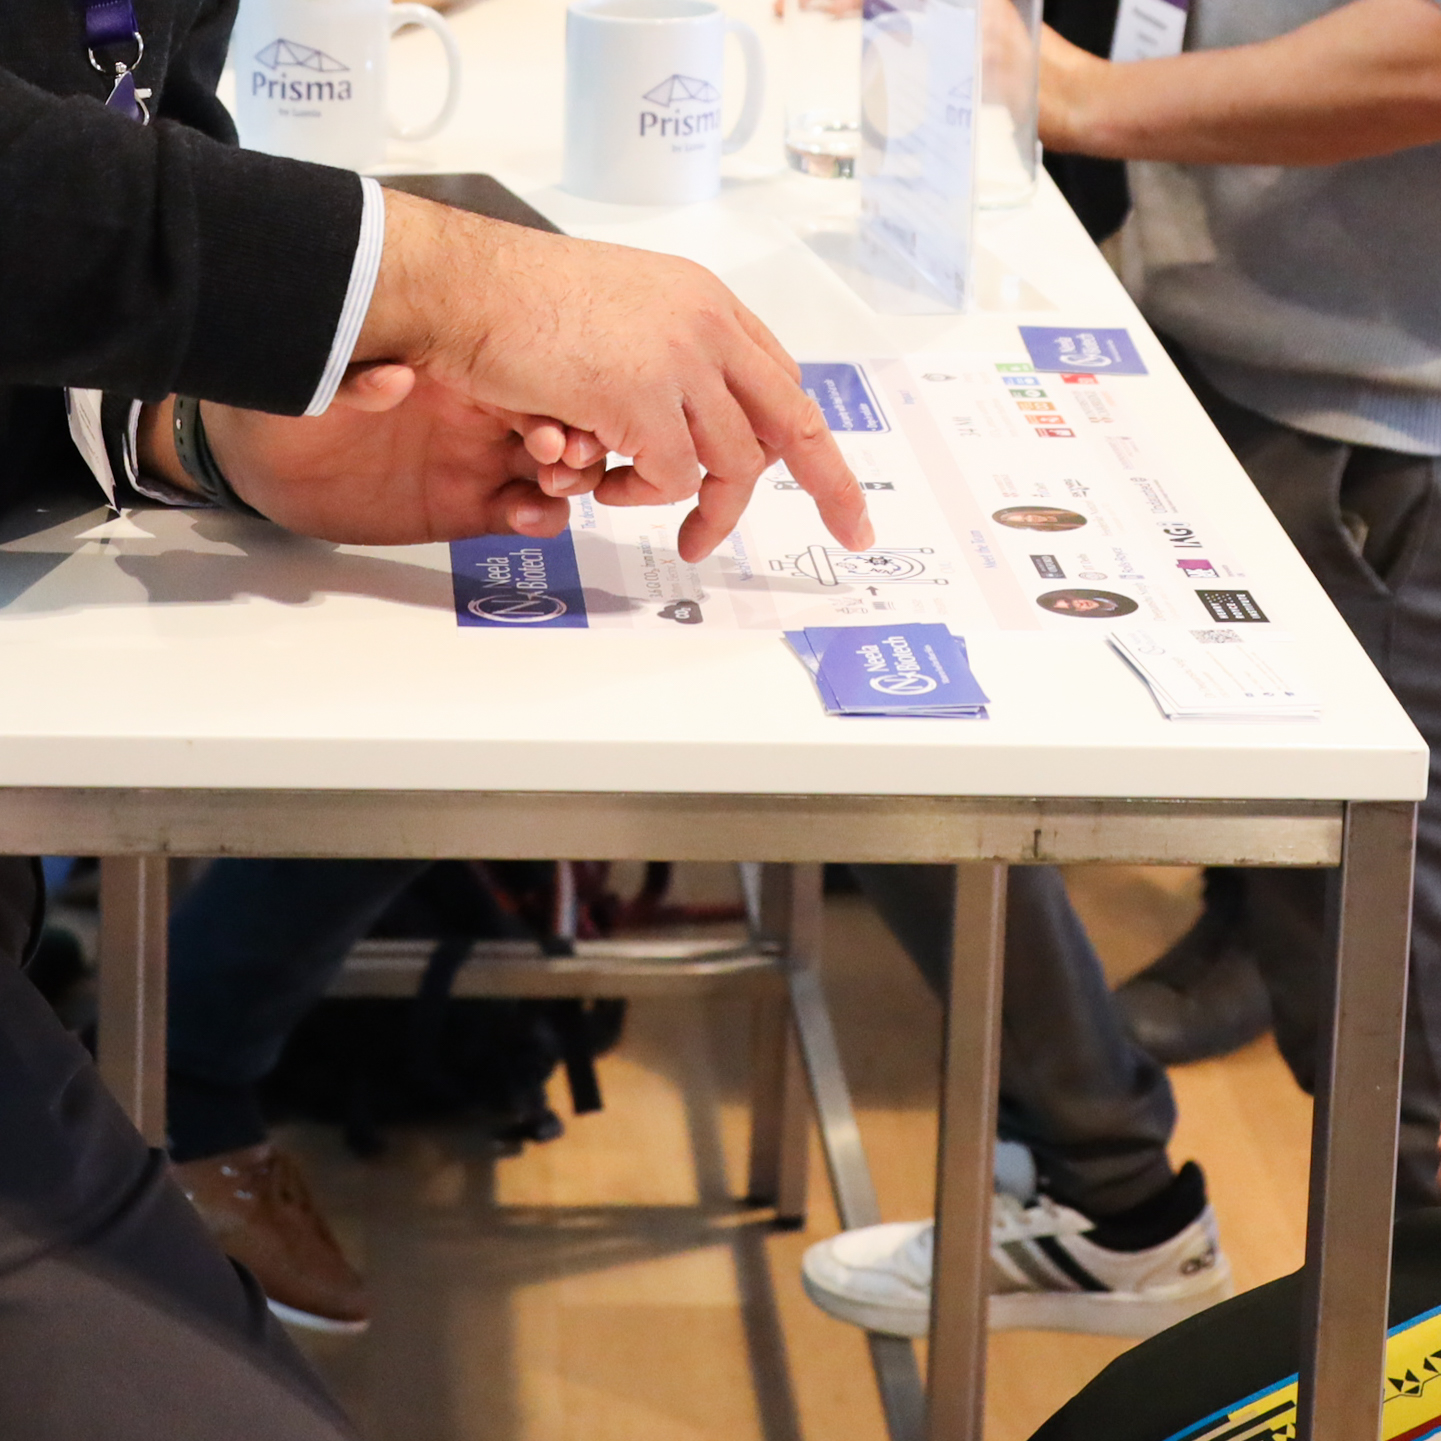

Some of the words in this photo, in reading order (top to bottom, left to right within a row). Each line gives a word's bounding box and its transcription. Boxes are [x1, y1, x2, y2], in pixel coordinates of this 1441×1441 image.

[252, 71, 352, 101] Prisma
[476, 555, 510, 589] Neela
[509, 547, 548, 590] Biotech
[856, 644, 890, 673] Neela
[881, 635, 921, 672] Biotech
